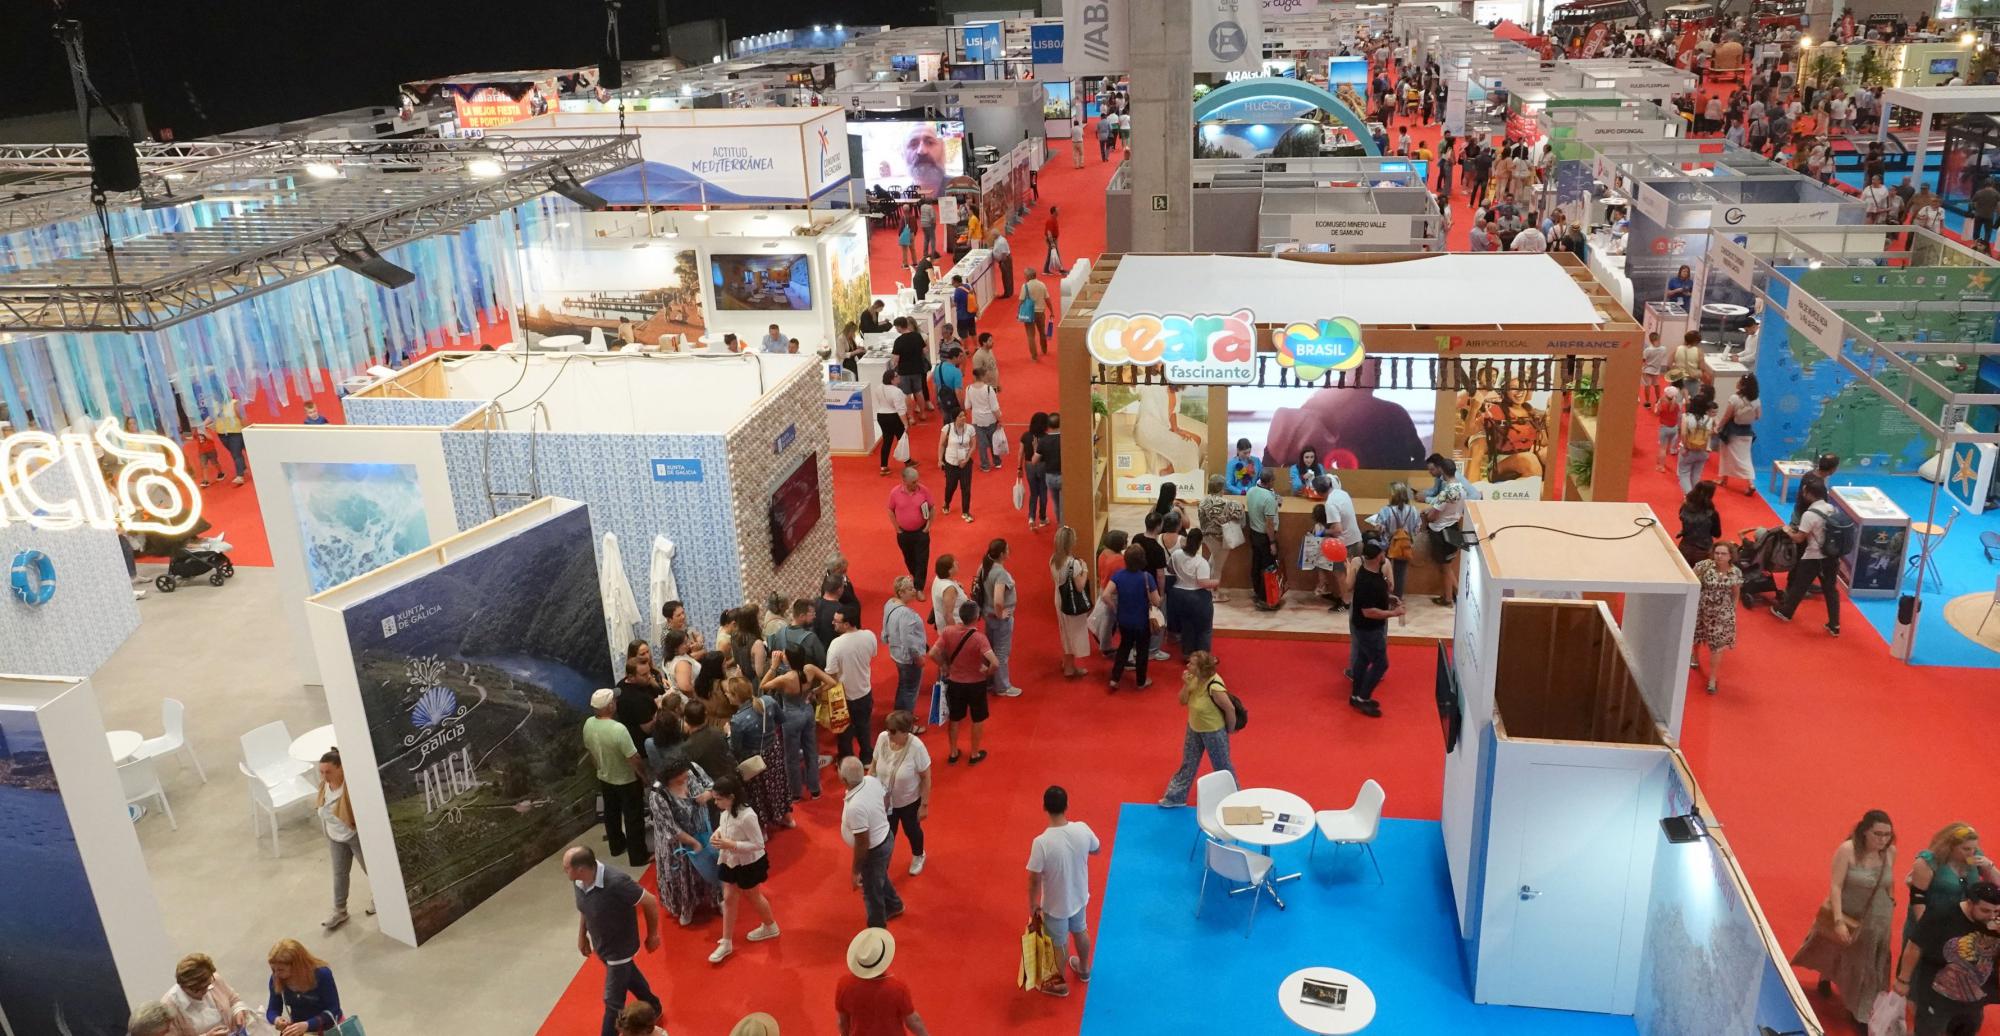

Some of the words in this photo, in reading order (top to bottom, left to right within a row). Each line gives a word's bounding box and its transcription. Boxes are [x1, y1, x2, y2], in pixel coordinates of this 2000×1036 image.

[966, 37, 999, 48] LISA
[712, 146, 748, 158] ACTITUD
[692, 155, 774, 173] MEDITERRÁNEA
[1090, 310, 1254, 362] ceará
[1434, 335, 1464, 351] TAP
[1296, 343, 1347, 356] BRASIL
[1170, 365, 1251, 379] fascinante
[1502, 488, 1530, 498] CEARÁ
[397, 603, 425, 621] XUNTA
[398, 616, 412, 630] DE
[411, 604, 443, 624] GALICIA
[420, 723, 466, 755] galicia
[424, 746, 478, 815] AUGA
